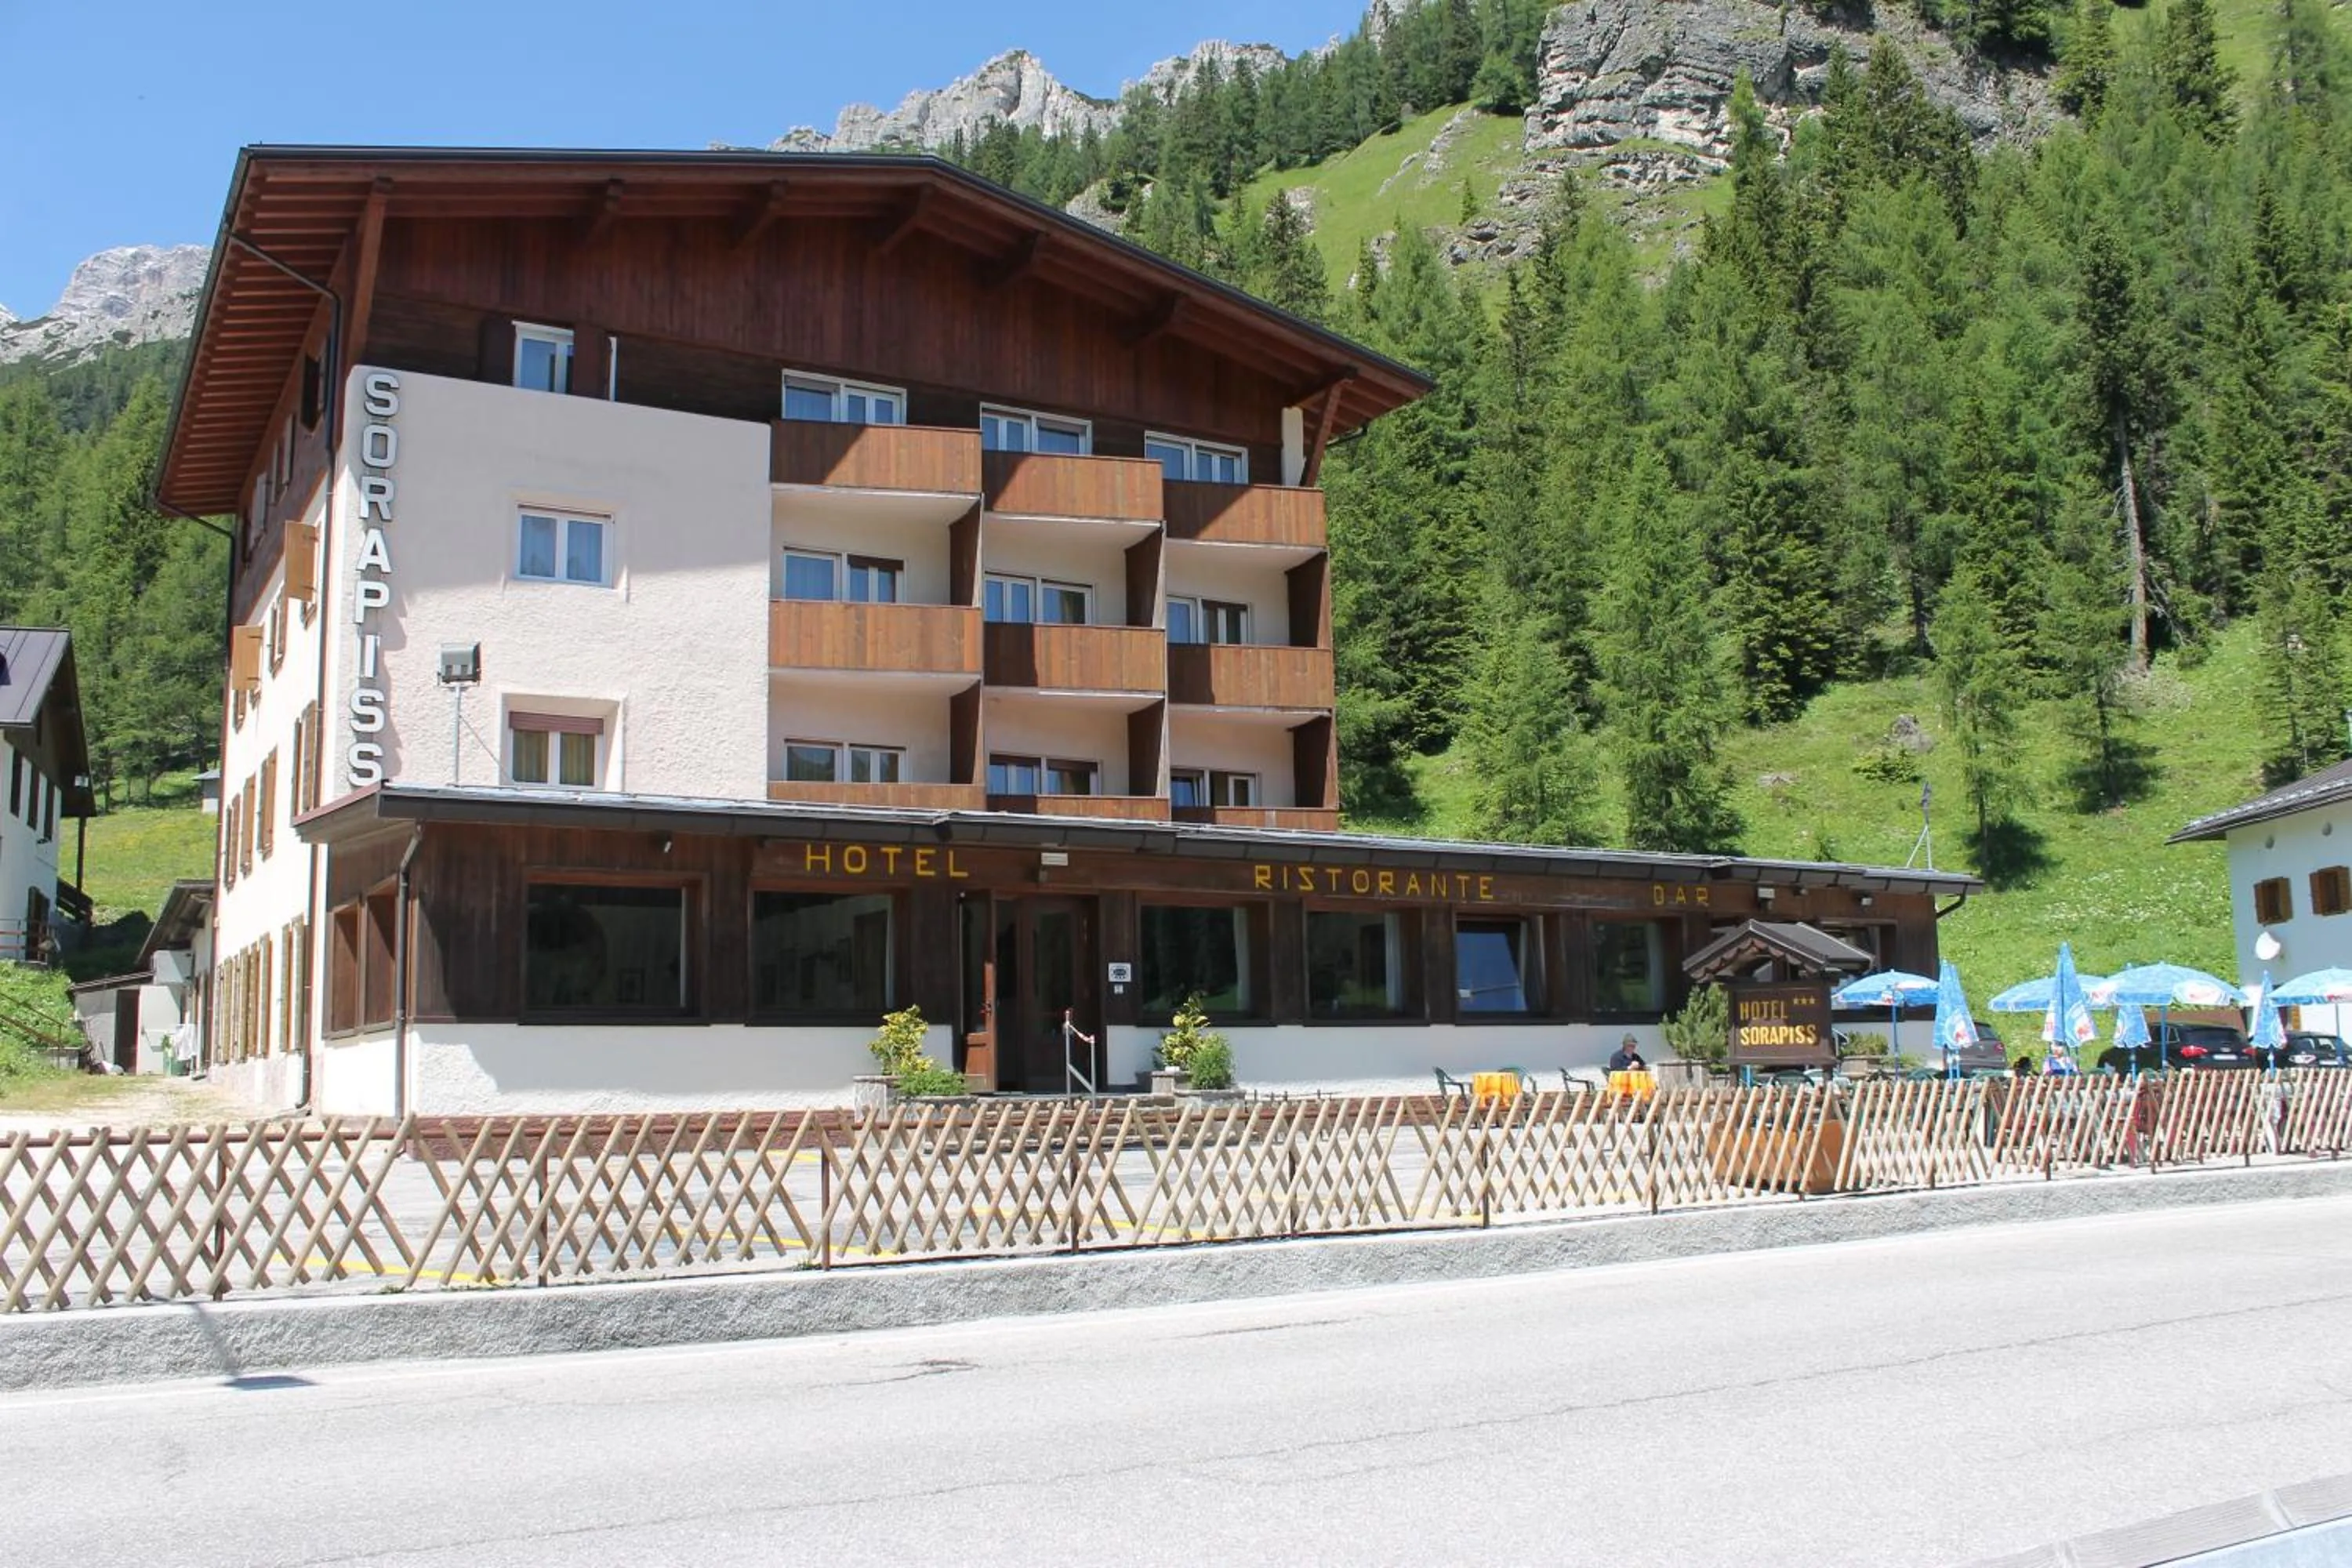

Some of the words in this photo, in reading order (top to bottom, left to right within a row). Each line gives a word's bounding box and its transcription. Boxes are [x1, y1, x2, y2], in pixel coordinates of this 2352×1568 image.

[347, 372, 401, 786] SORAPISS
[805, 844, 968, 877] HOTEL
[1254, 865, 1494, 899] RISTORANTE
[1740, 1001, 1788, 1020] HOTEL
[1740, 1025, 1817, 1045] SORAPISS
